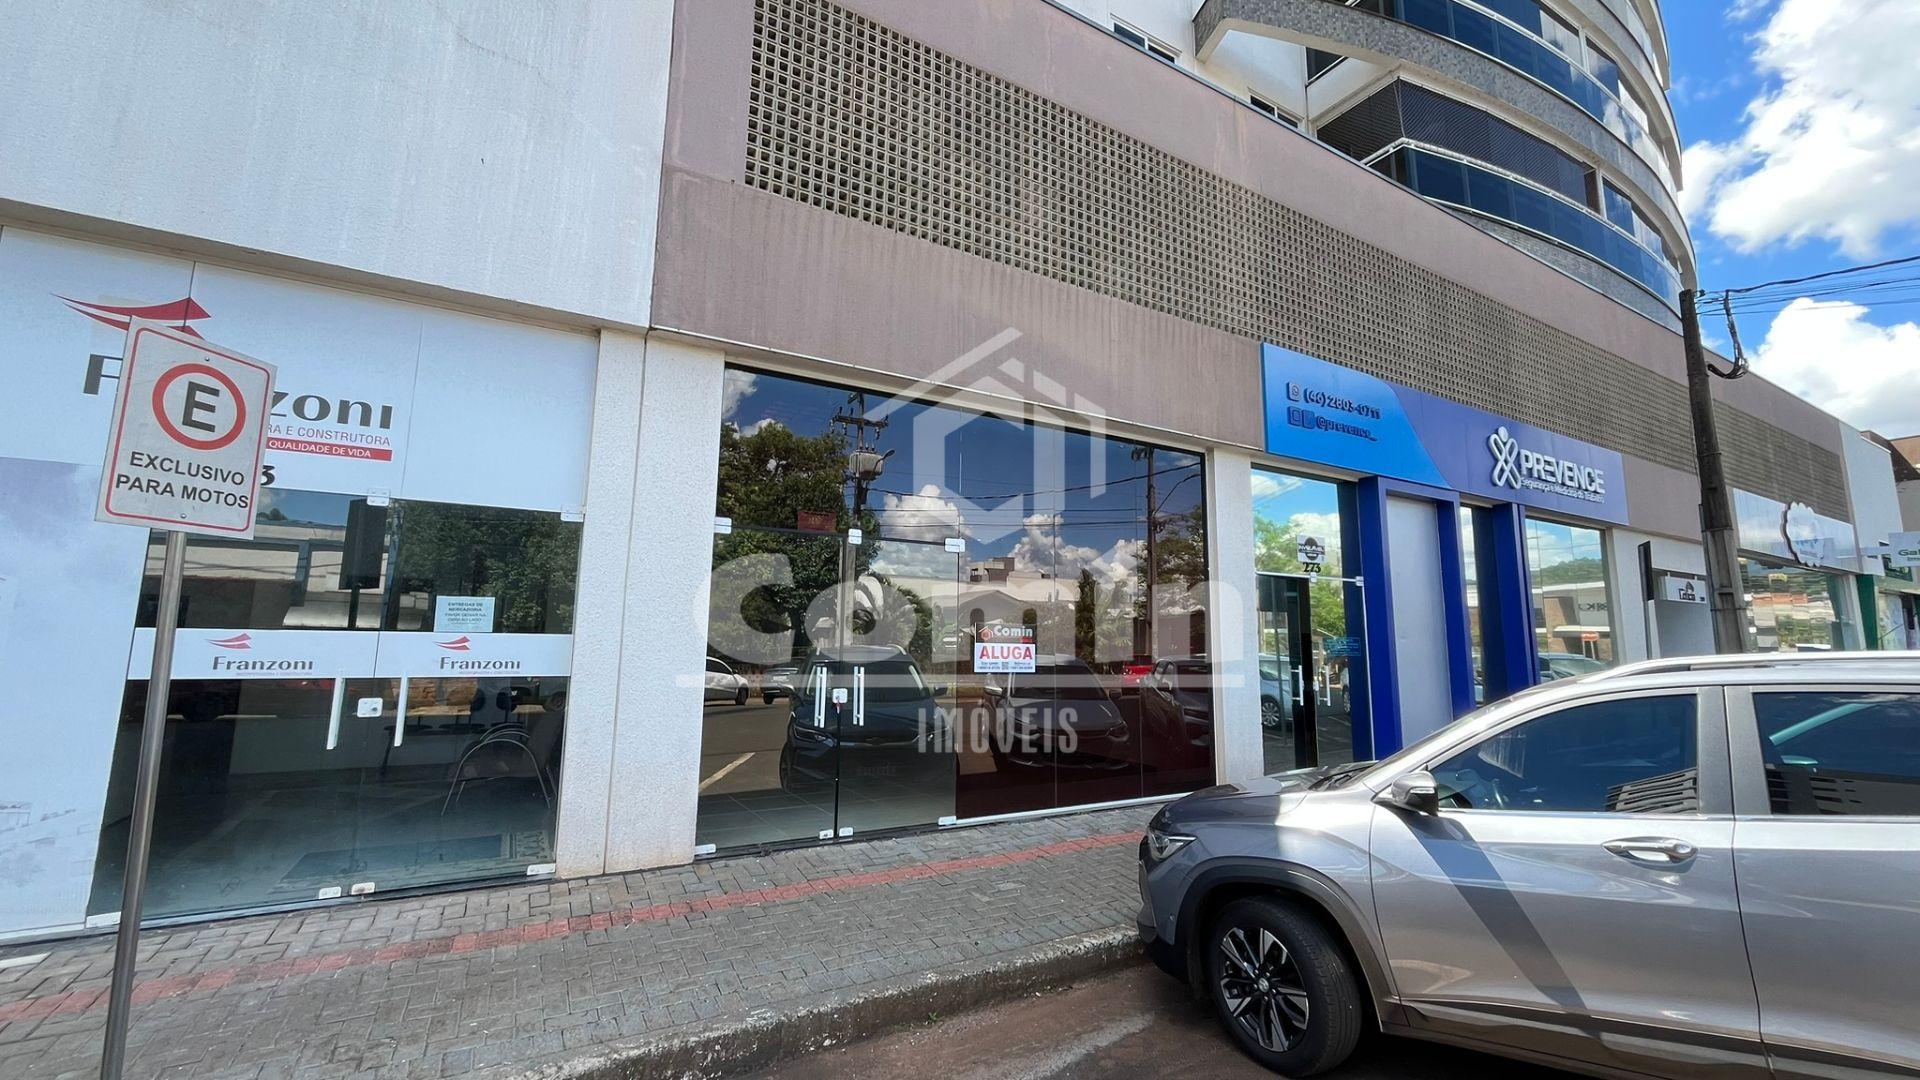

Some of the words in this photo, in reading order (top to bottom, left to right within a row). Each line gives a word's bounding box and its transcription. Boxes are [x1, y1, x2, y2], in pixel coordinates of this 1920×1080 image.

[83, 353, 393, 430] Fzoni
[182, 381, 220, 432] E
[297, 425, 391, 446] CONSTRUTORA
[268, 440, 330, 454] QUALIDADE
[332, 447, 346, 455] DE
[347, 448, 372, 458] VIDA
[129, 450, 246, 487] EXCLUSIVO
[1520, 449, 1605, 494] PREVENCE
[115, 473, 175, 498] PARA
[180, 485, 250, 510] MOTOS
[1302, 562, 1322, 574] 273
[993, 625, 1034, 637] Comin
[979, 645, 1034, 660] ALUGA
[212, 655, 314, 671] Franzoni
[440, 656, 521, 670] Franzoni
